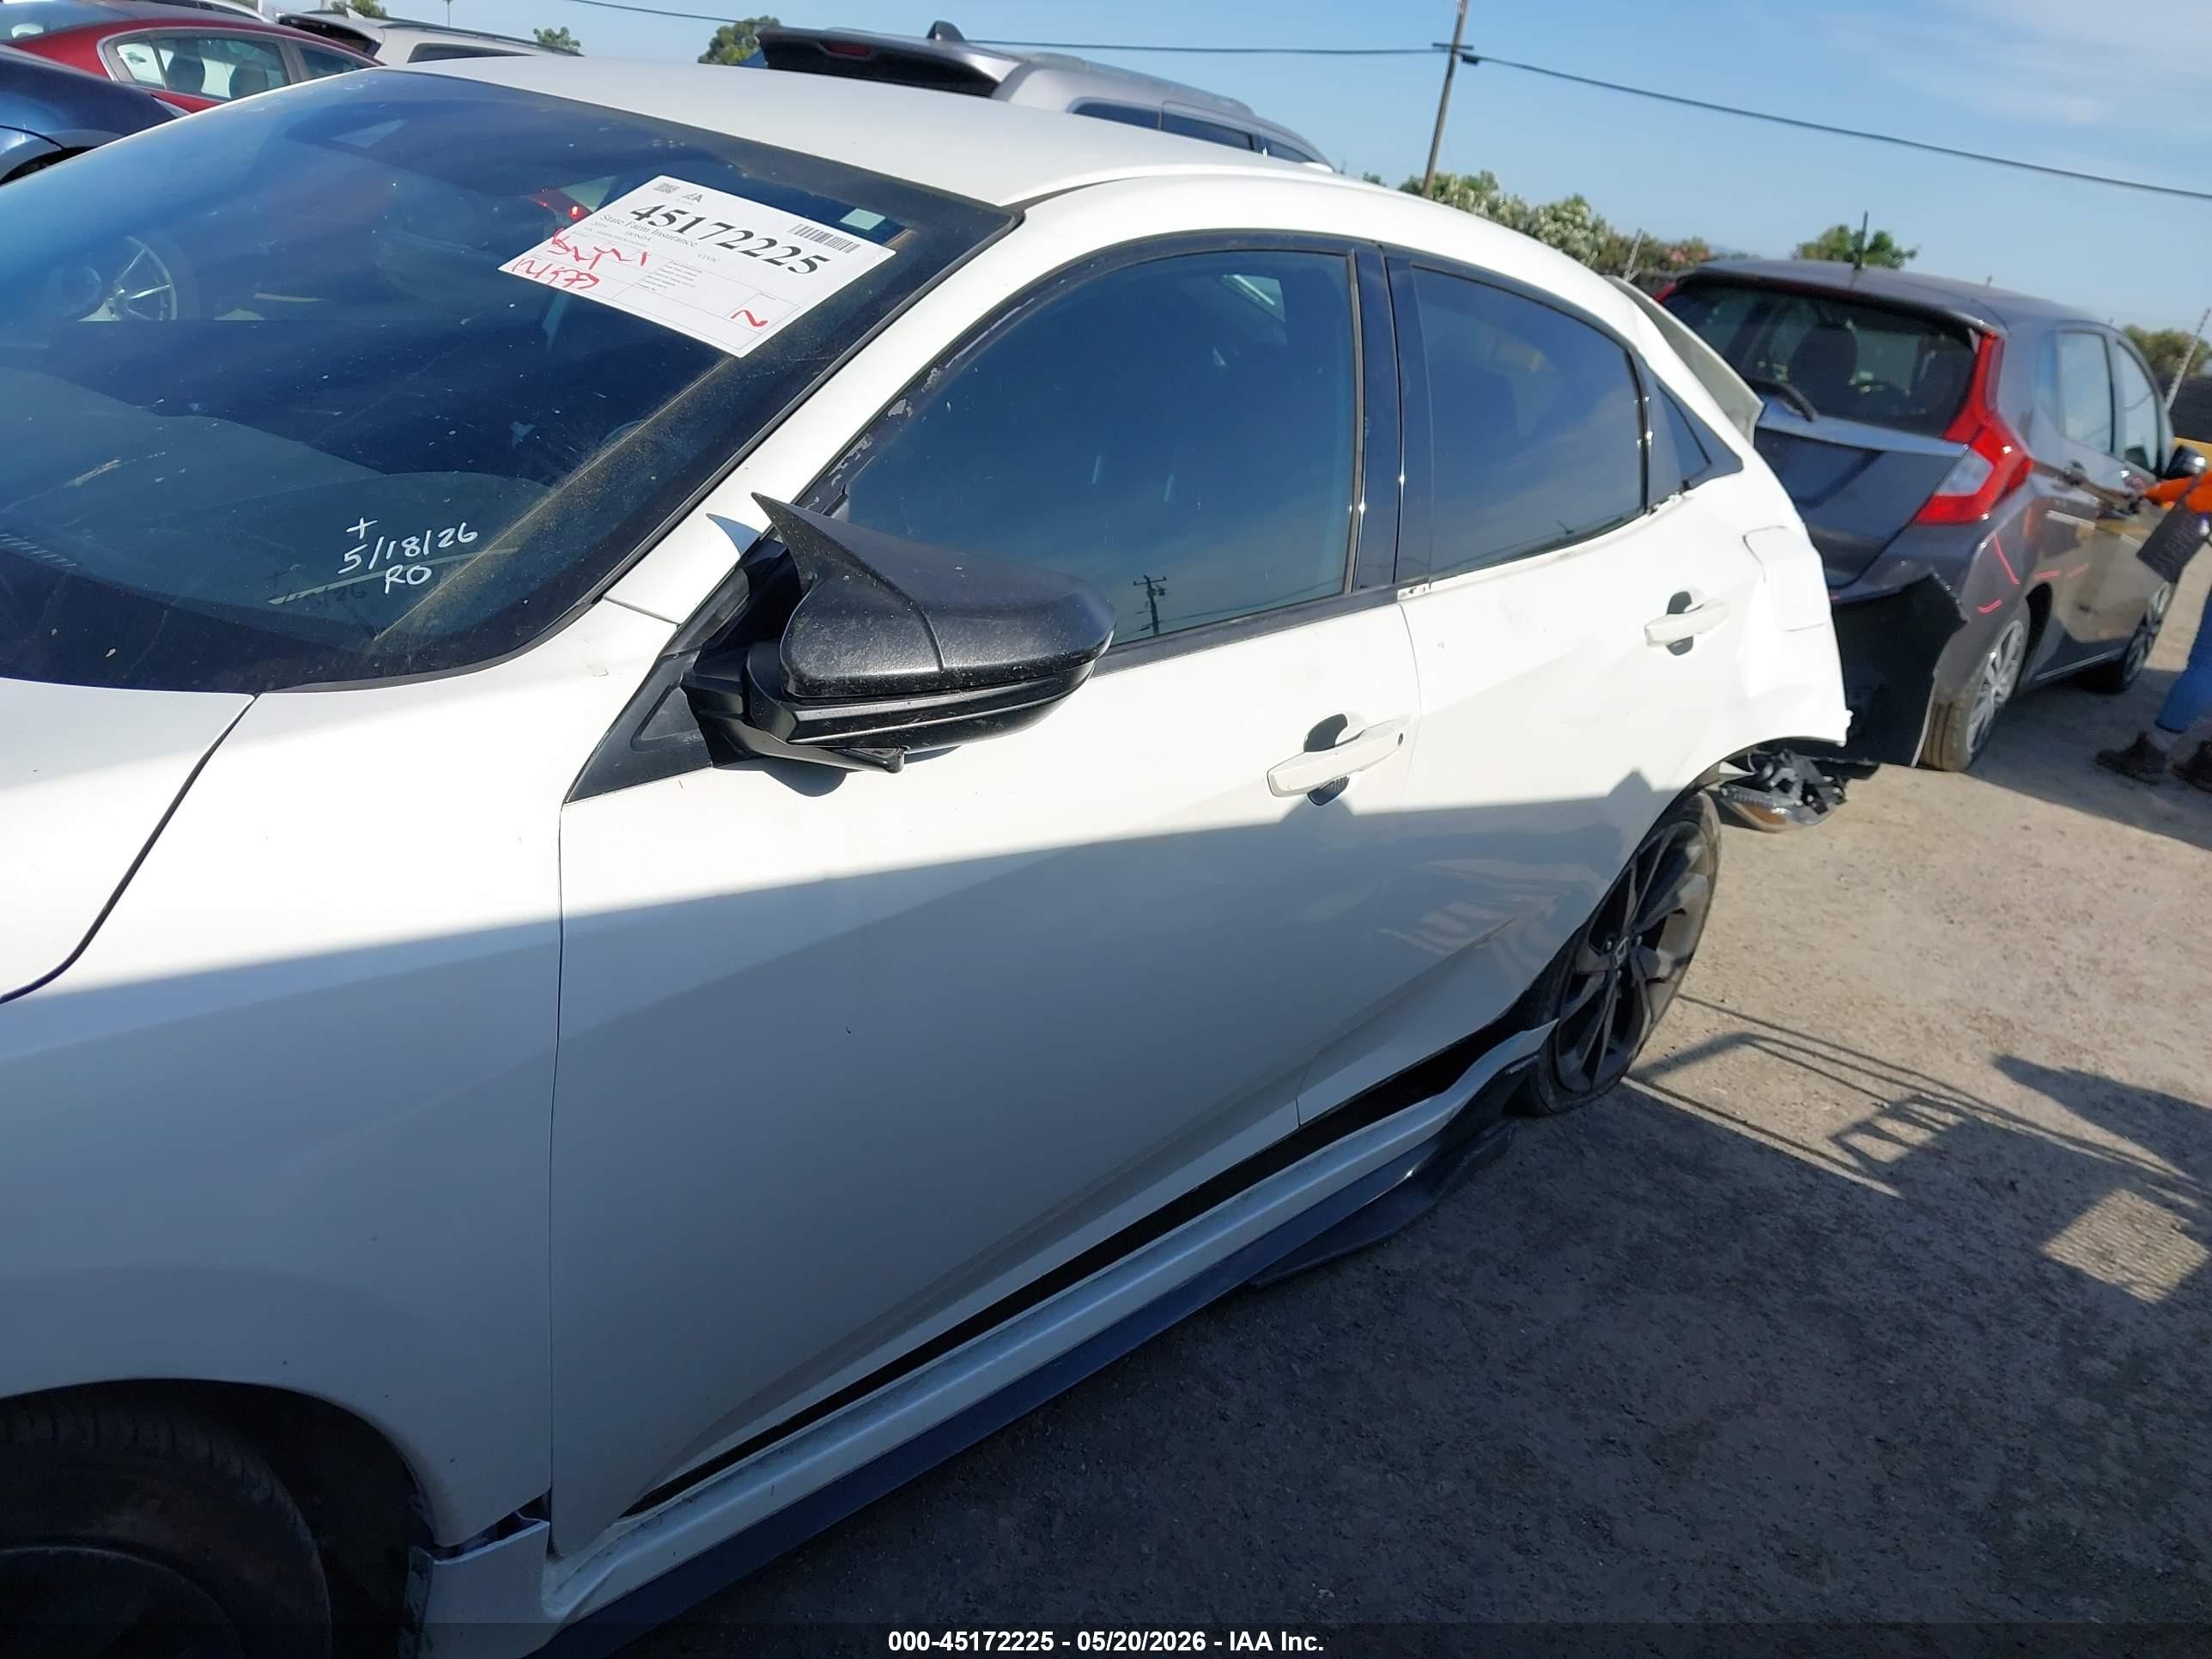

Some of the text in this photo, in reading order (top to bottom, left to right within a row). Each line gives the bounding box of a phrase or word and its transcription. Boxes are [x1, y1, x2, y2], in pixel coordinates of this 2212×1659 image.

[600, 214, 625, 226] State
[624, 221, 652, 234] Farm
[651, 227, 698, 247] Insurance
[629, 204, 832, 276] 45172225
